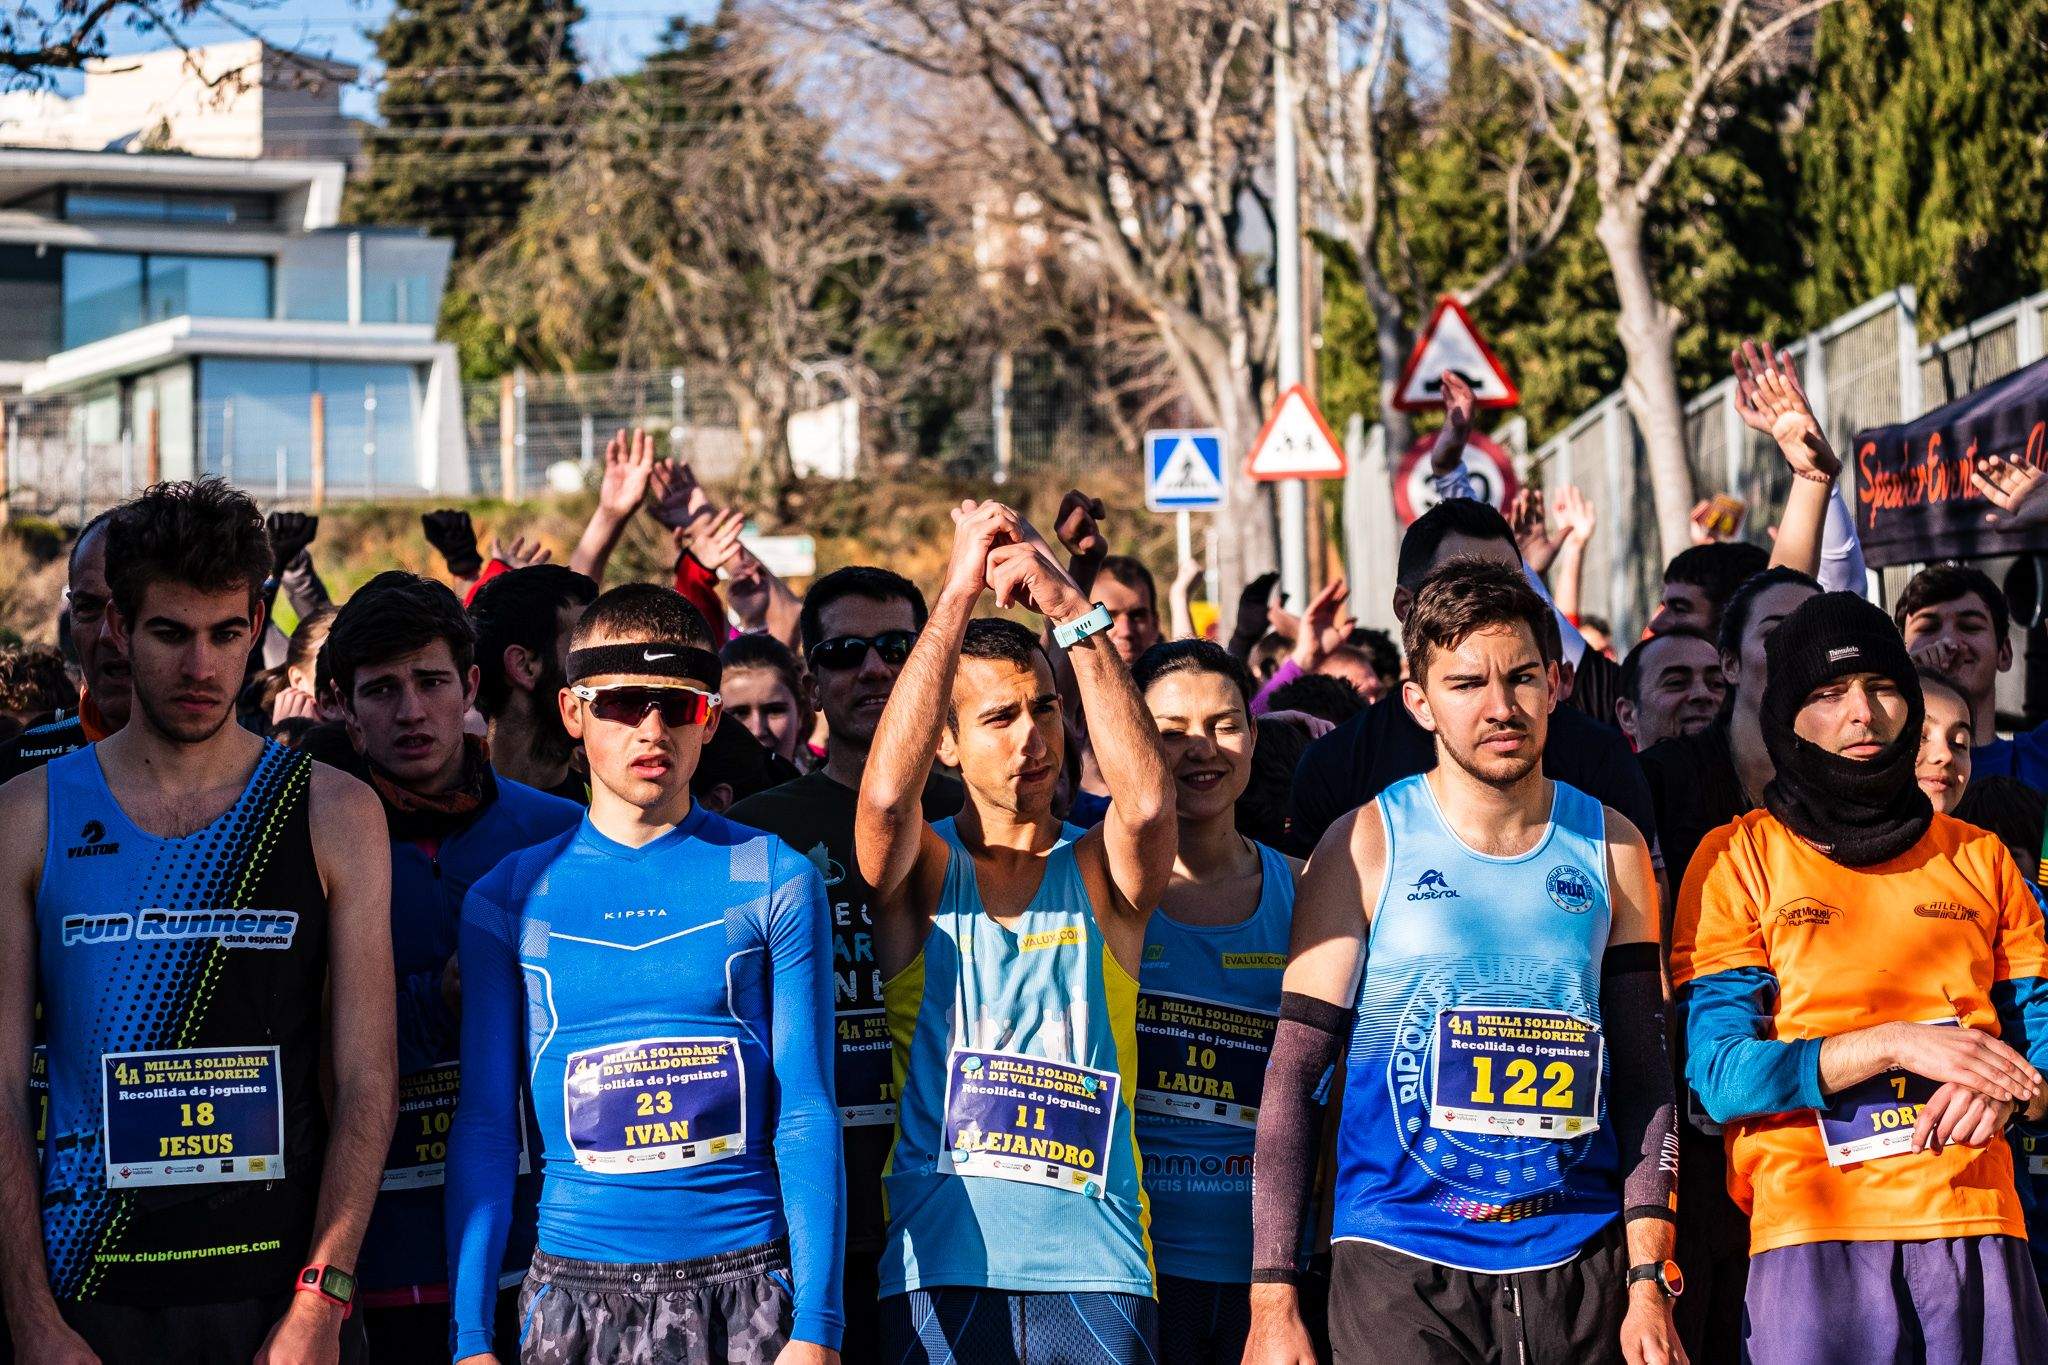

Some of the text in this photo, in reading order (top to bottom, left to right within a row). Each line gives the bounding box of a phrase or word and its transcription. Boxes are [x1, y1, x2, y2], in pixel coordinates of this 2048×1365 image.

[20, 745, 63, 757] luanvi
[604, 909, 667, 920] KIPSTA
[65, 912, 296, 942] Fun Runners
[224, 934, 288, 945] club esportiu
[1162, 1001, 1203, 1017] MILLA
[838, 1020, 861, 1040] 4A
[1161, 1012, 1264, 1039] DE VALLDOREIX
[1448, 1015, 1473, 1036] 4A
[1478, 1015, 1521, 1027] MILLA
[1136, 1023, 1268, 1053] Recollida de joguines
[1478, 1026, 1585, 1043] DE VALLDOREIX
[603, 1050, 648, 1065] MILLA
[1186, 1045, 1216, 1070] 10
[1451, 1039, 1590, 1058] Recollida de joguines
[115, 1062, 140, 1085] 4A
[144, 1055, 269, 1072] MILLA SOLIDÀRIA
[604, 1056, 720, 1076] DE VALLDOREIX
[989, 1060, 1034, 1075] MILLA
[145, 1068, 260, 1084] DE VALLDOREIX
[647, 1075, 664, 1087] de
[666, 1069, 728, 1086] joguines
[988, 1072, 1008, 1082] DE
[1158, 1070, 1235, 1100] LAURA
[1471, 1056, 1575, 1109] 122
[119, 1084, 267, 1100] Recollida de joguines
[1890, 1076, 1906, 1099] 7
[636, 1090, 673, 1117] 23
[961, 1083, 1102, 1115] Recollida de joguines
[180, 1102, 215, 1127] 18
[1015, 1103, 1046, 1131] 11
[625, 1120, 689, 1147] IVAN
[159, 1133, 234, 1158] JESUS
[954, 1129, 1096, 1169] ALEJANDRO
[95, 1239, 281, 1263] www.clubfunrunners.com
